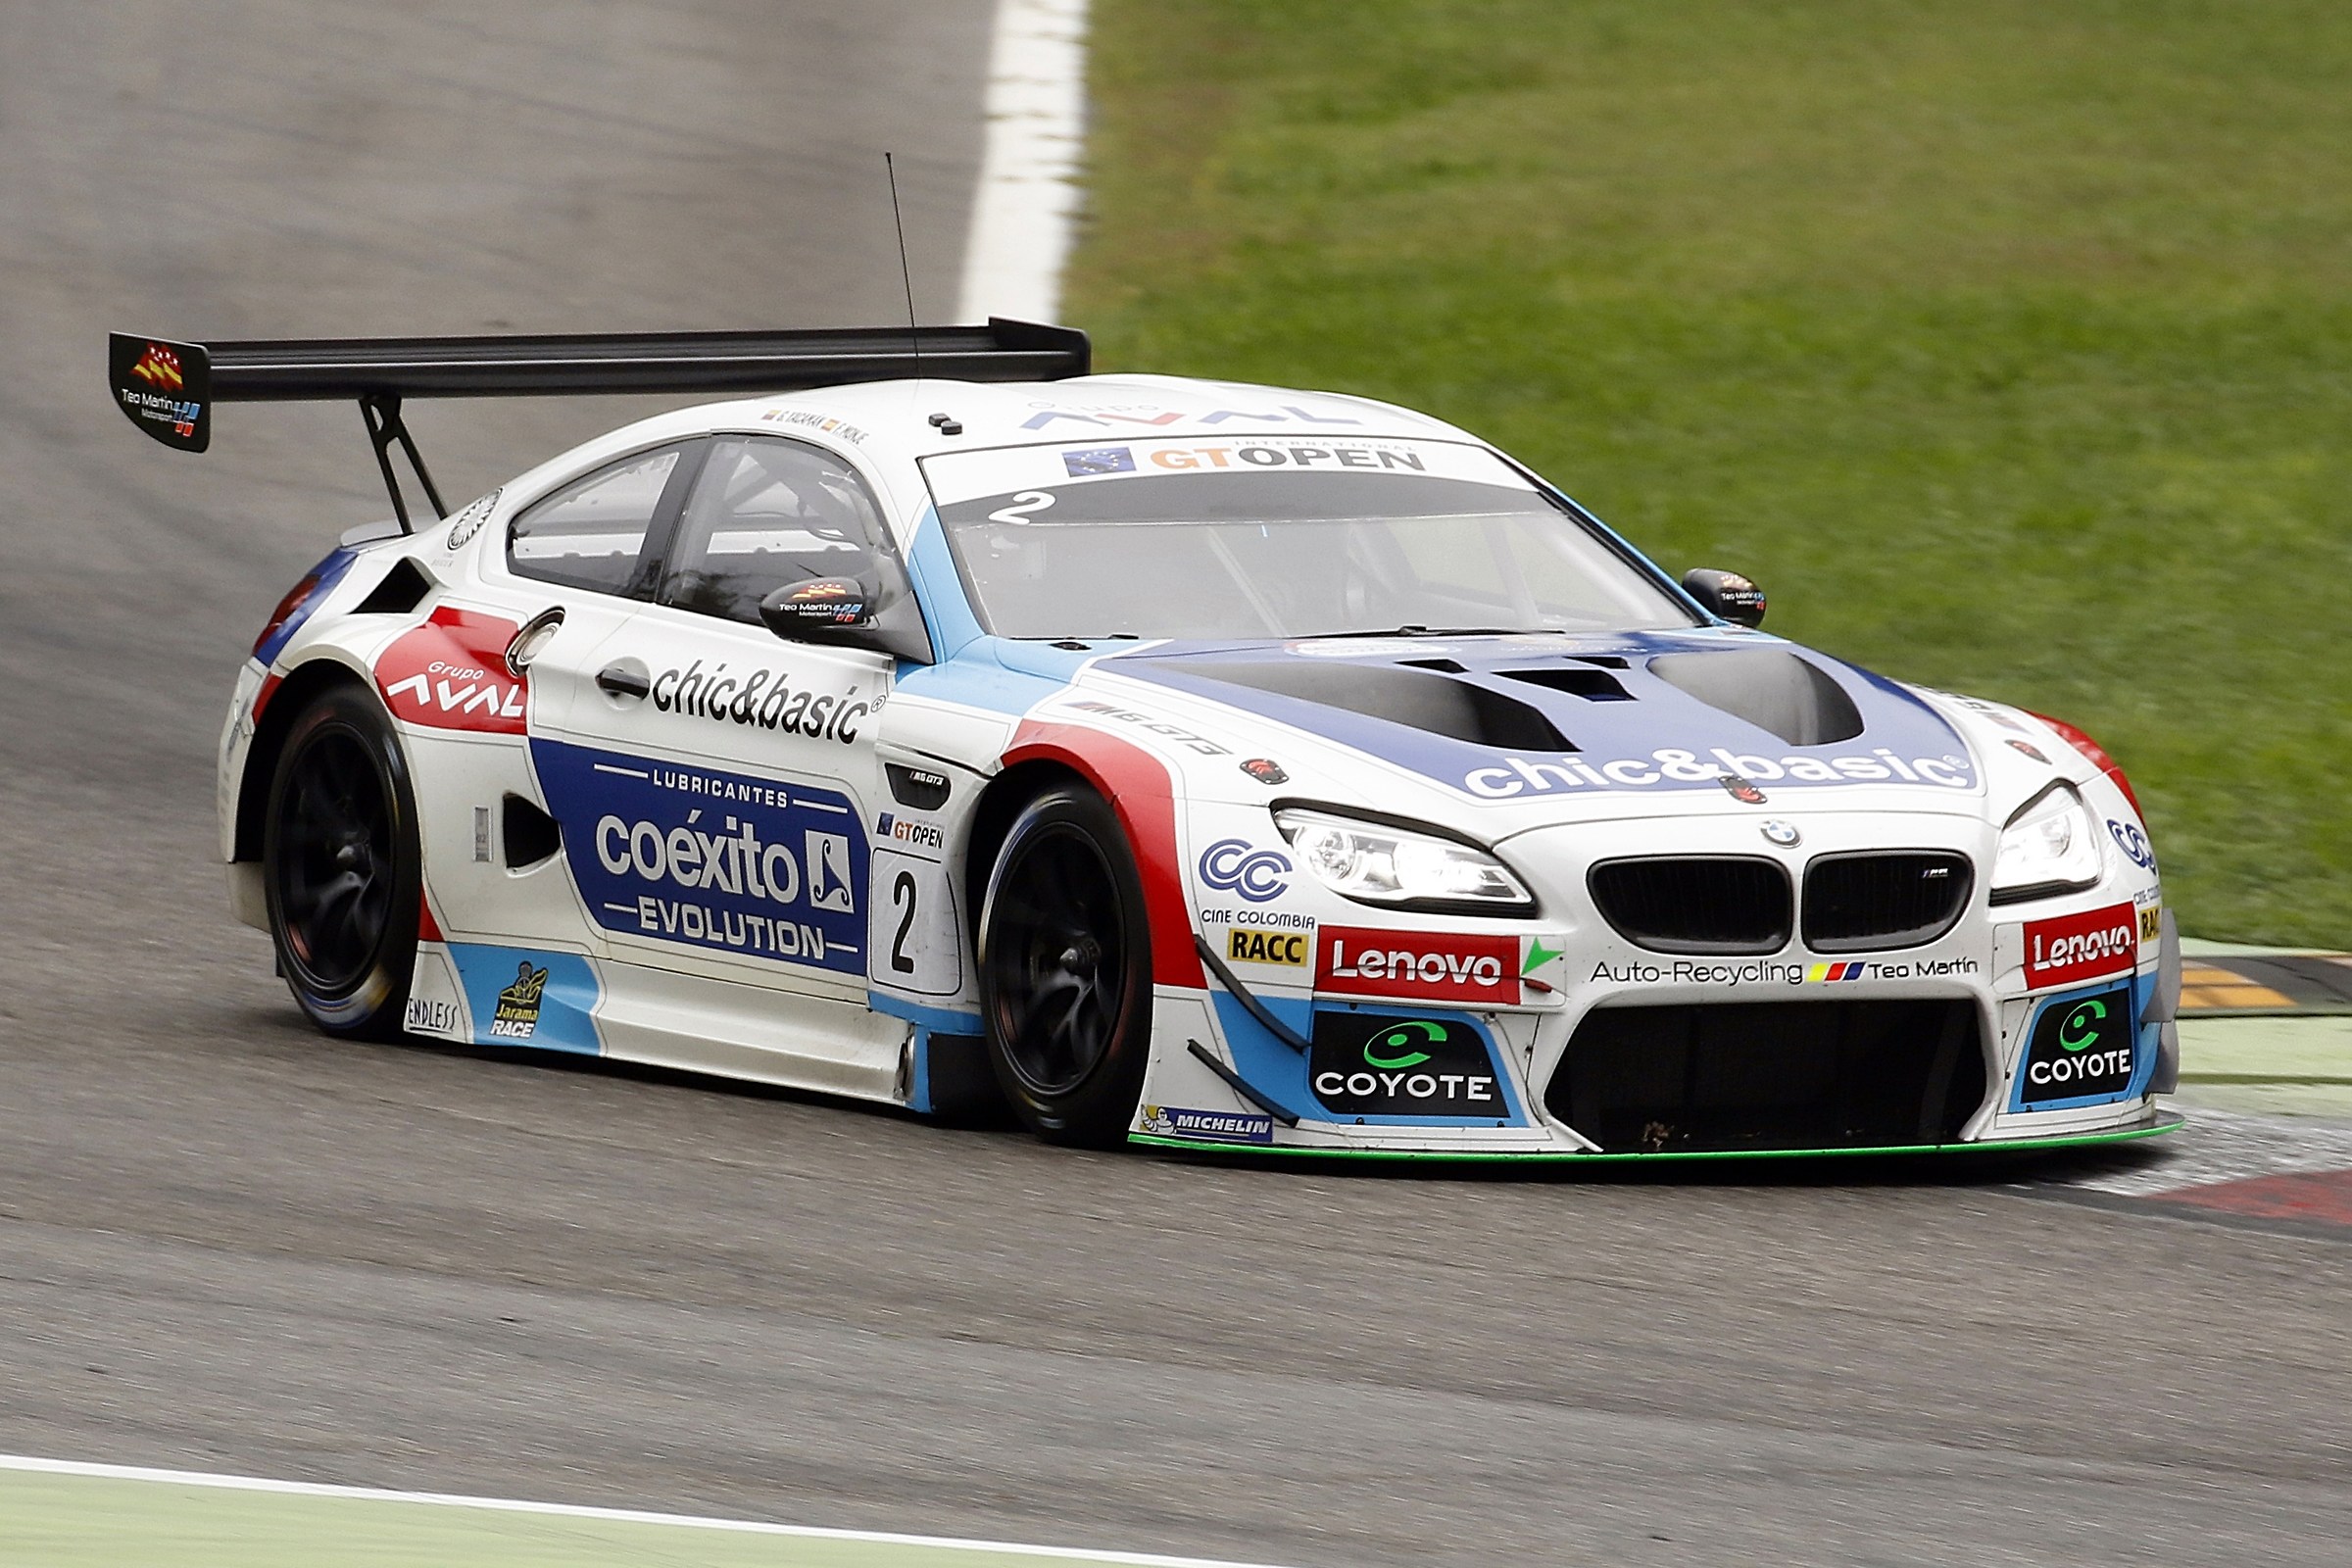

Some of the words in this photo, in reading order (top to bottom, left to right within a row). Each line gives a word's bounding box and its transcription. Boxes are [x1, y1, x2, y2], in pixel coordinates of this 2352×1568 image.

[121, 388, 140, 404] Teo
[988, 491, 1057, 524] 2
[428, 661, 485, 680] Grupo
[387, 673, 524, 717] AVAL
[654, 768, 788, 808] LUBRICANTES
[596, 808, 800, 904] coéxito
[637, 896, 825, 960] EVOLUTION
[891, 870, 916, 974] 2
[1201, 909, 1232, 923] CINE
[1237, 910, 1316, 930] COLOMBIA
[1232, 931, 1302, 963] RACC
[1333, 940, 1501, 986] Lenovo
[2033, 924, 2132, 971] Lenovo
[1591, 960, 1803, 986] Auto-Recycling
[1868, 963, 1909, 979] Teo
[408, 998, 458, 1030] ENDLESS
[497, 1004, 539, 1021] Jarama
[490, 1019, 535, 1039] RACE
[2031, 1049, 2132, 1085] COYOTE
[1315, 1072, 1493, 1102] COYOTE
[1176, 1114, 1271, 1134] MICHELIN
